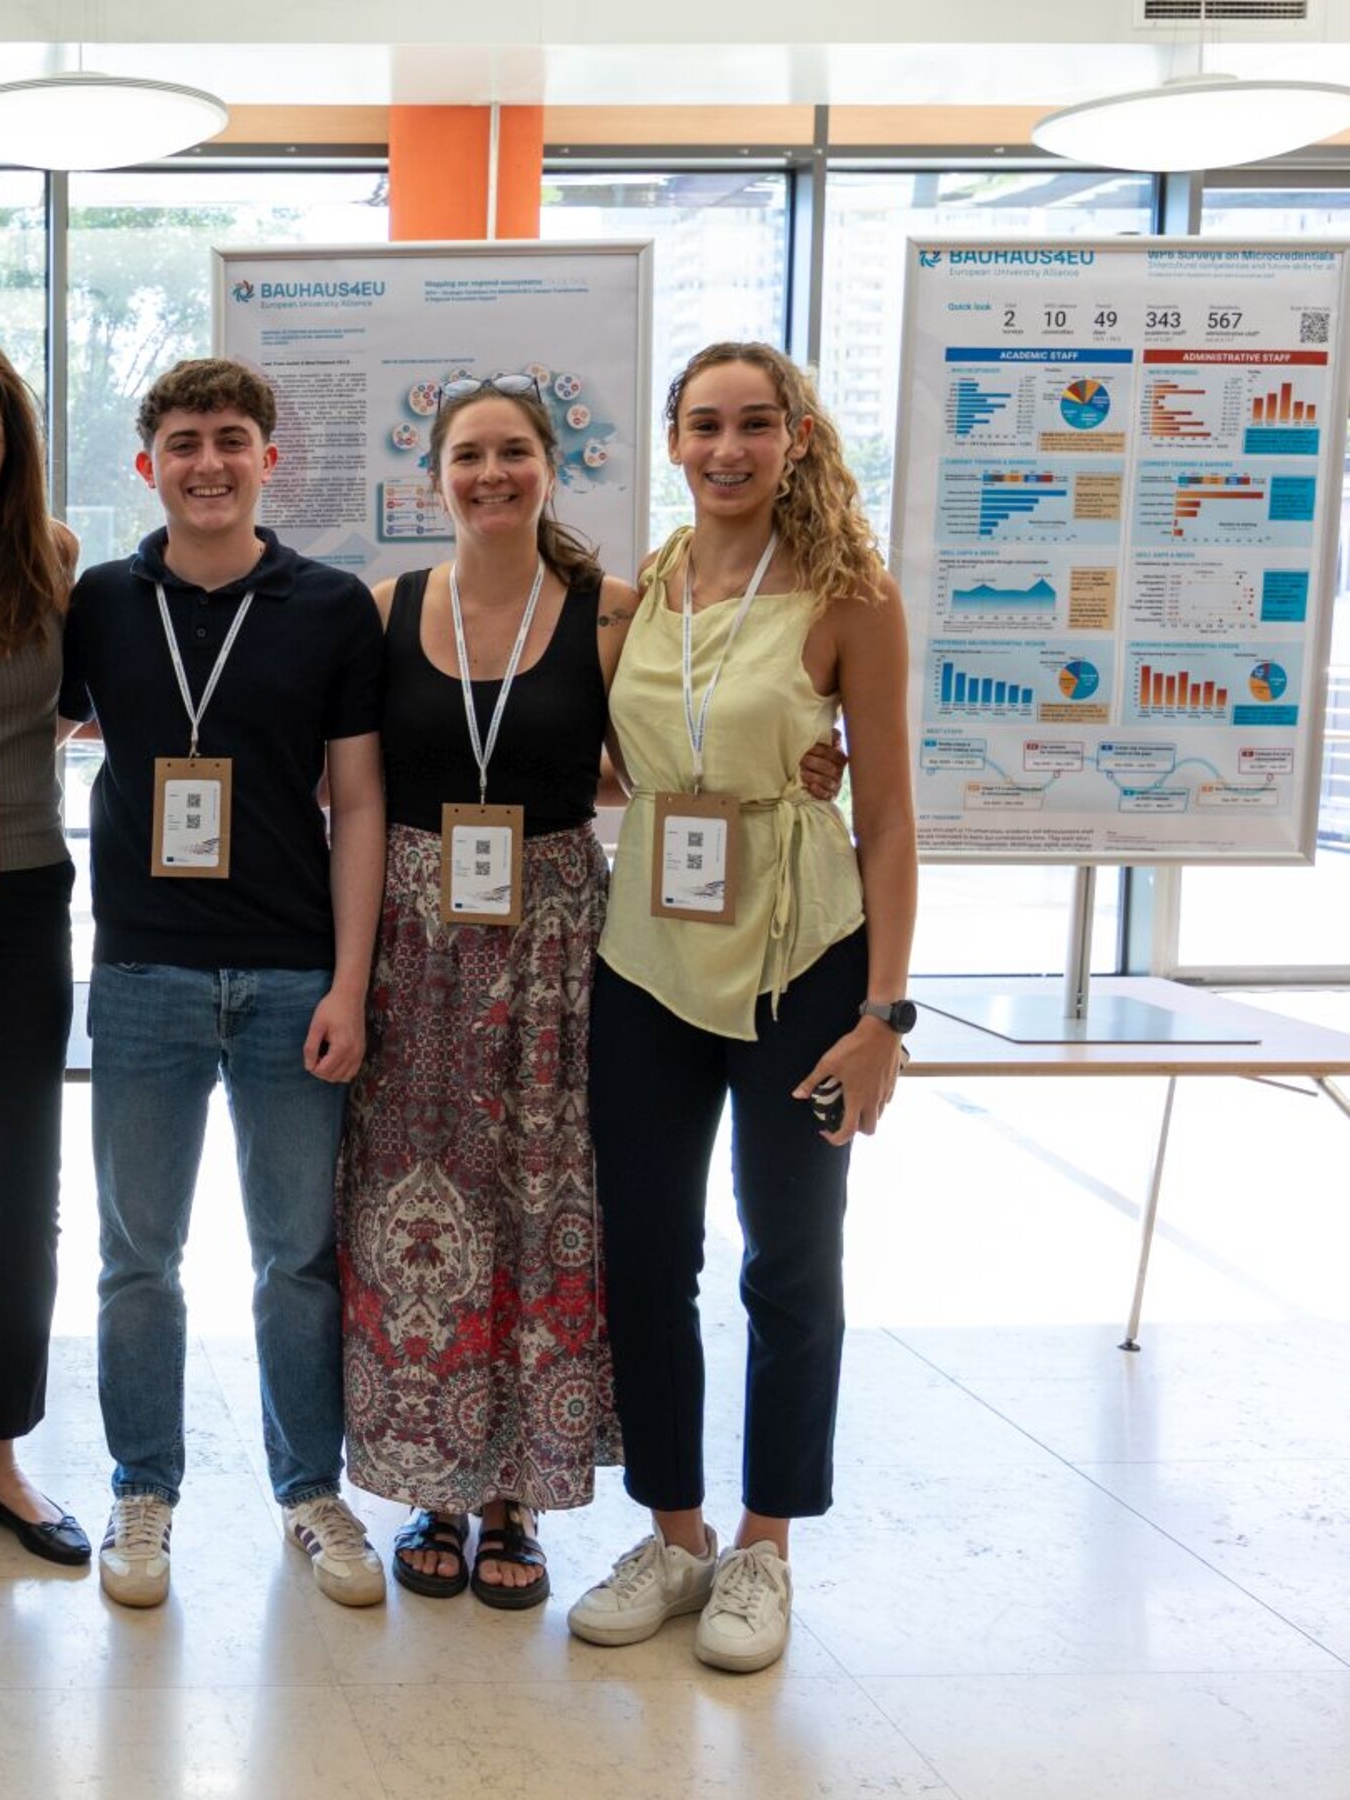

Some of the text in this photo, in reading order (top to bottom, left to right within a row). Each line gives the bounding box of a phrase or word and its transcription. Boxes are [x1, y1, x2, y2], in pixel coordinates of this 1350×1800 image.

[950, 250, 1094, 264] BAUHAUS4EU
[1176, 250, 1222, 262] Surveys
[1226, 252, 1240, 260] on
[1242, 250, 1335, 260] Microcredentials
[950, 268, 1080, 278] European University Alliance
[260, 281, 385, 298] BAUHAUS4EU
[260, 300, 372, 310] European University Alliance
[948, 303, 992, 312] Quick look
[1004, 310, 1016, 328] 2
[1044, 310, 1066, 328] 10
[1094, 310, 1118, 328] 49
[1145, 312, 1182, 328] 343
[1207, 312, 1244, 329] 567
[1000, 352, 1078, 360] ACADEMIC STAFF
[1182, 352, 1291, 362] ADMINISTRATIVE STAFF
